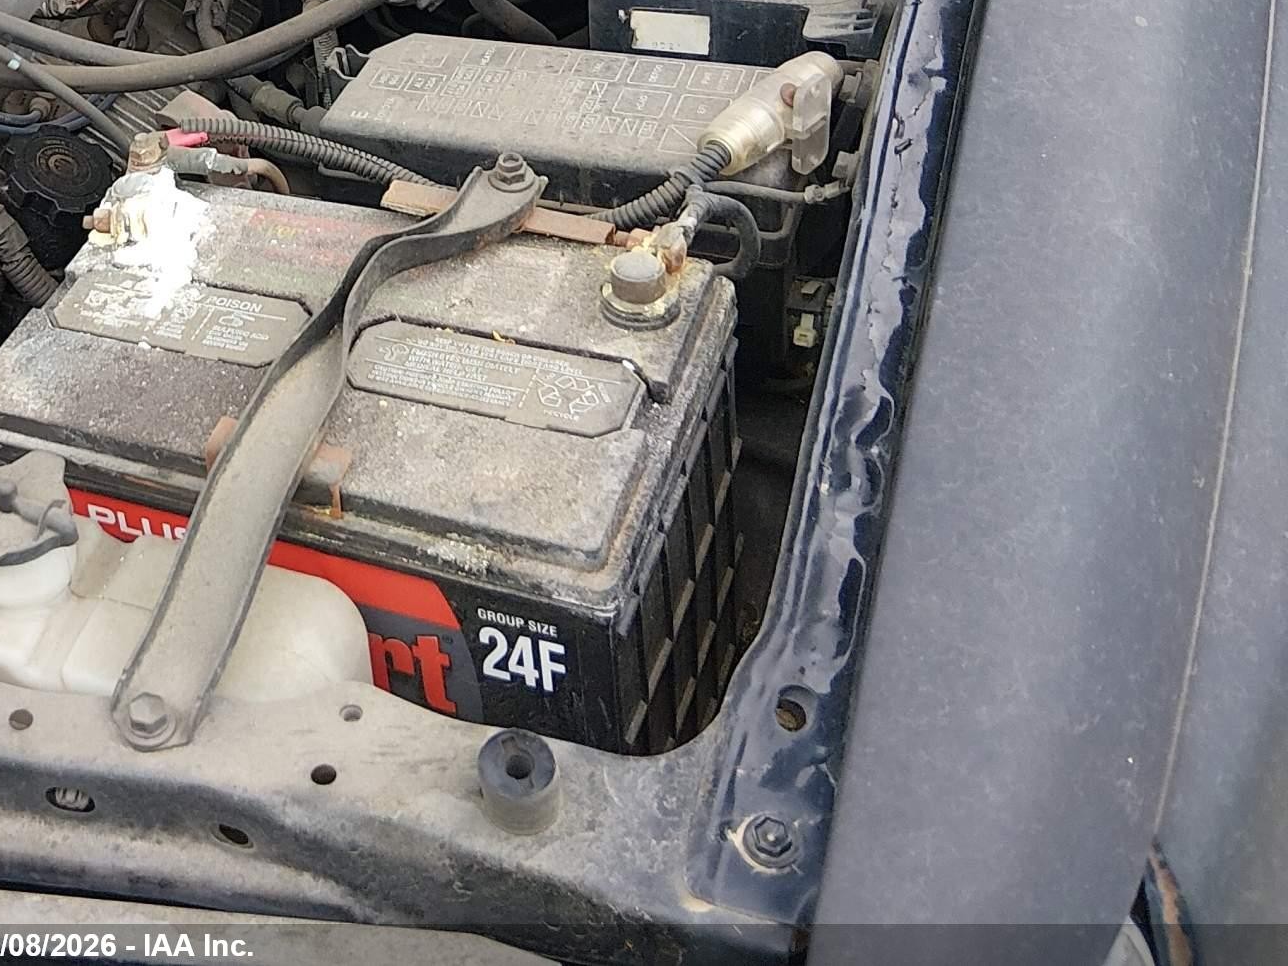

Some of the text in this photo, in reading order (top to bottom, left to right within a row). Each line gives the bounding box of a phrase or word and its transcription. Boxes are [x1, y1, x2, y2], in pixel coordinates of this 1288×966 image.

[205, 295, 263, 312] POISON
[477, 608, 558, 638] GROUP SIZE
[478, 626, 567, 693] 24F
